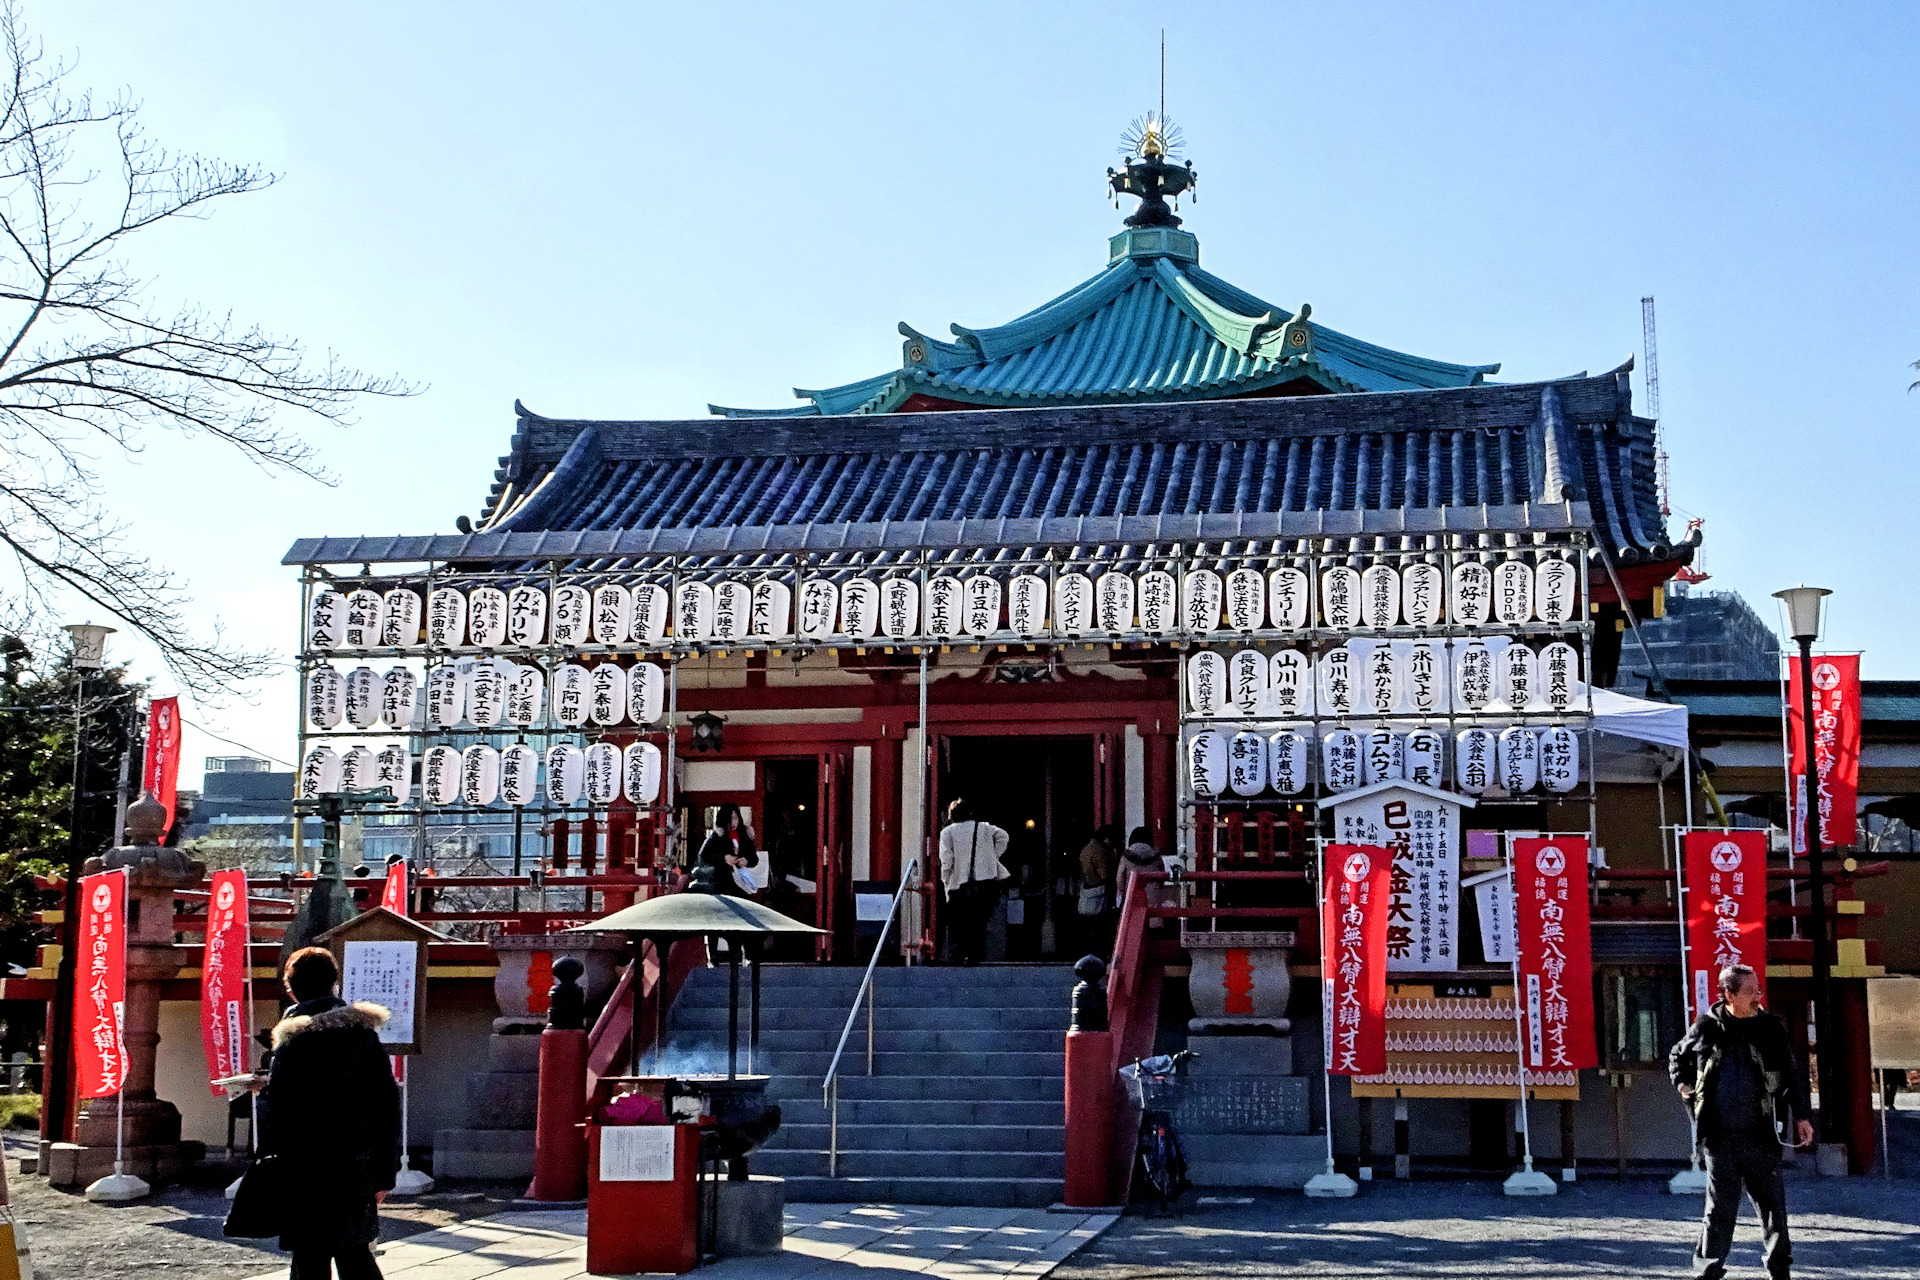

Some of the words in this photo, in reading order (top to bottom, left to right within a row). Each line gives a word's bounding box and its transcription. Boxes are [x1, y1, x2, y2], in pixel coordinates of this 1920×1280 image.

[311, 593, 335, 647] 東叡会
[472, 591, 488, 644] いかるが
[510, 589, 531, 643] カナリヤ
[555, 589, 574, 640] つる瀬
[598, 590, 620, 642] 韻松亭
[633, 586, 655, 641] 朝日信用金庫
[680, 584, 699, 639] 上野精養軒
[803, 582, 822, 633] みはし
[845, 581, 867, 636] 二木の菓子
[889, 581, 909, 636] 上野観光連盟
[930, 578, 953, 635] 林家正蔵
[1459, 566, 1482, 620] 精好堂
[383, 671, 401, 724] なかほり
[473, 670, 494, 724] 三愛工芸
[1238, 653, 1259, 710] 長良グループ
[1276, 653, 1299, 707] 山川豊
[1329, 651, 1350, 708] 田川寿美
[1372, 650, 1394, 708] 水森かおり
[1411, 650, 1434, 707] 氷川きよし
[503, 747, 522, 803] 近藤板金
[1232, 738, 1250, 786] 喜泉
[1329, 746, 1343, 789] 株式会社
[1341, 734, 1358, 785] 須藤石材
[1411, 735, 1433, 787] 石長
[1542, 743, 1558, 788] 東京本社
[1555, 731, 1572, 780] はせがわ
[1437, 804, 1450, 859] 九月十五日
